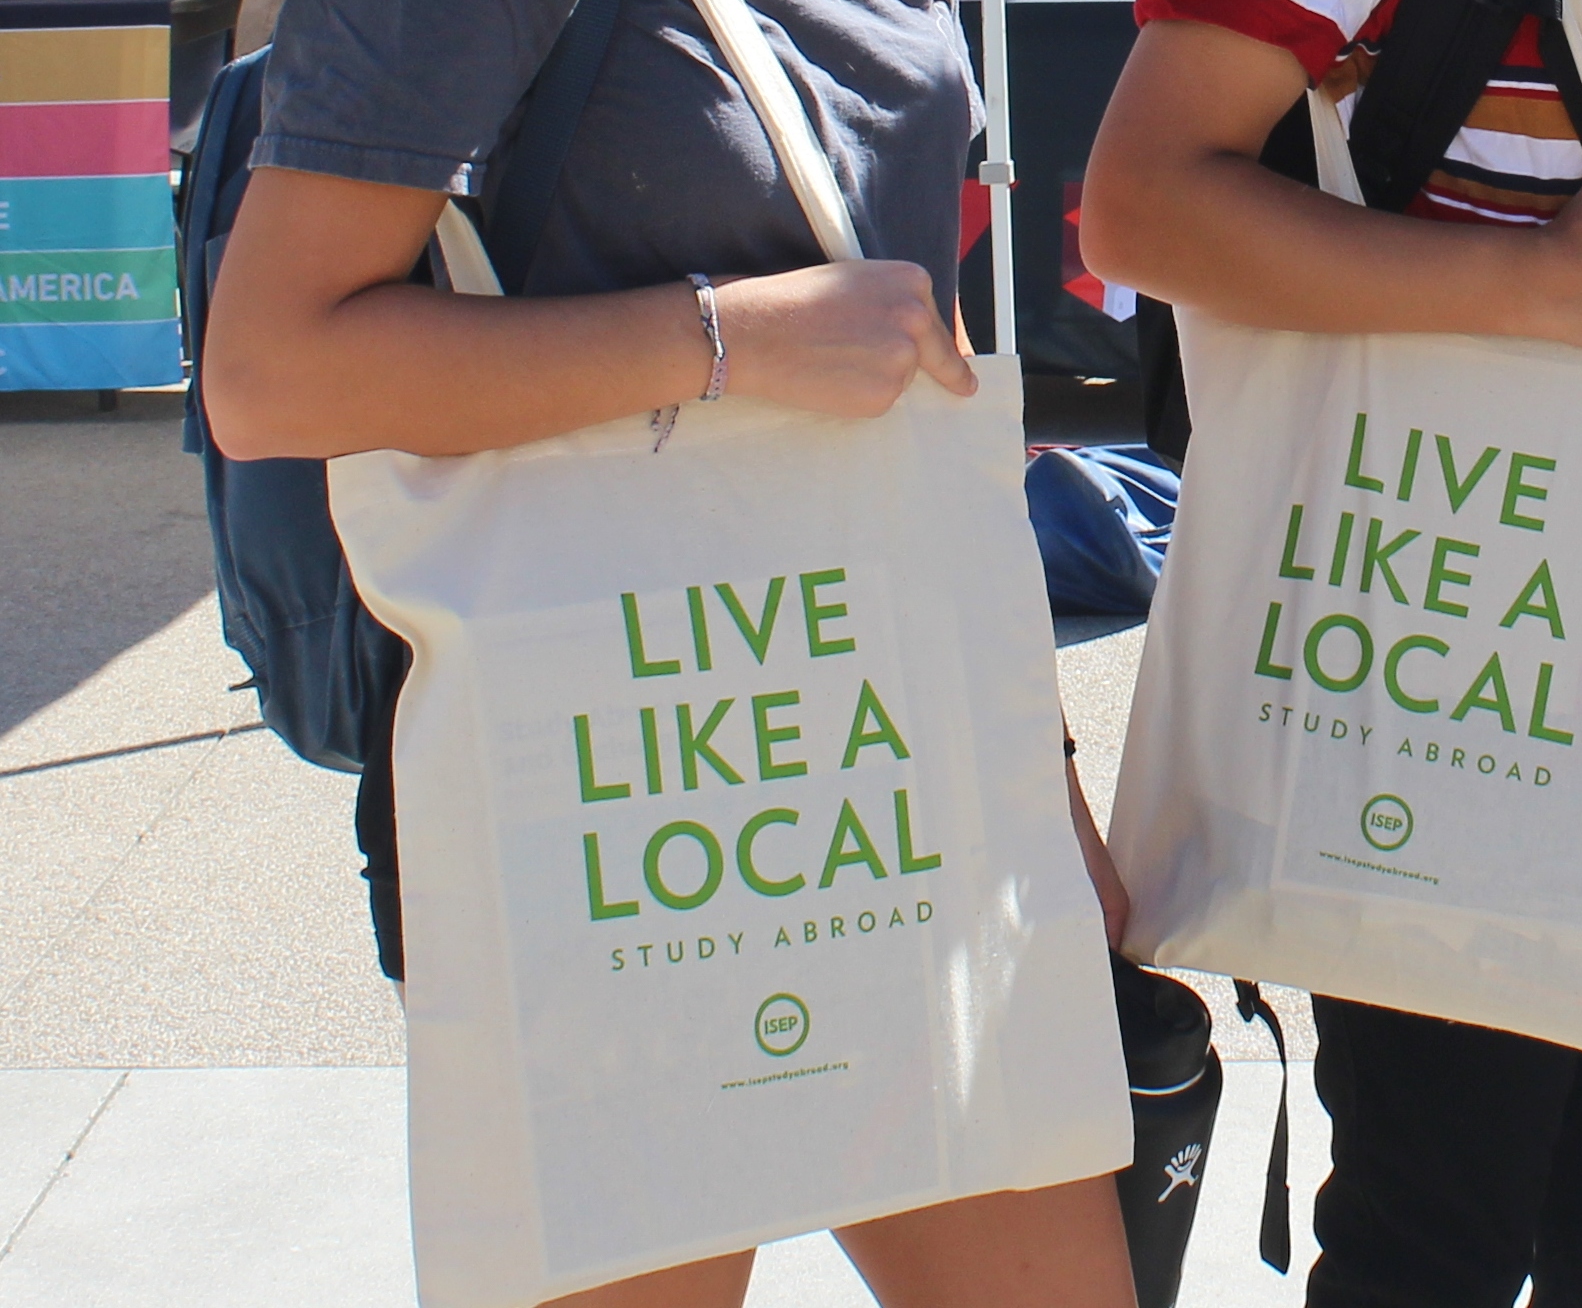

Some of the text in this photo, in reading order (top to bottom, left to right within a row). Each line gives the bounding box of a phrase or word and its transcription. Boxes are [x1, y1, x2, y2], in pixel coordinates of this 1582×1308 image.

[1346, 412, 1556, 530] LIVE
[624, 568, 856, 676] LIVE
[1280, 504, 1564, 637] LIKE A
[1255, 601, 1574, 746] LOCAL
[576, 680, 910, 801] LIKE A
[1258, 703, 1551, 784] STUDY ABROAD
[584, 789, 942, 921] LOCAL
[1370, 813, 1403, 831] ISEP
[613, 901, 934, 969] STUDY ABROAD
[764, 1015, 798, 1035] ISEP
